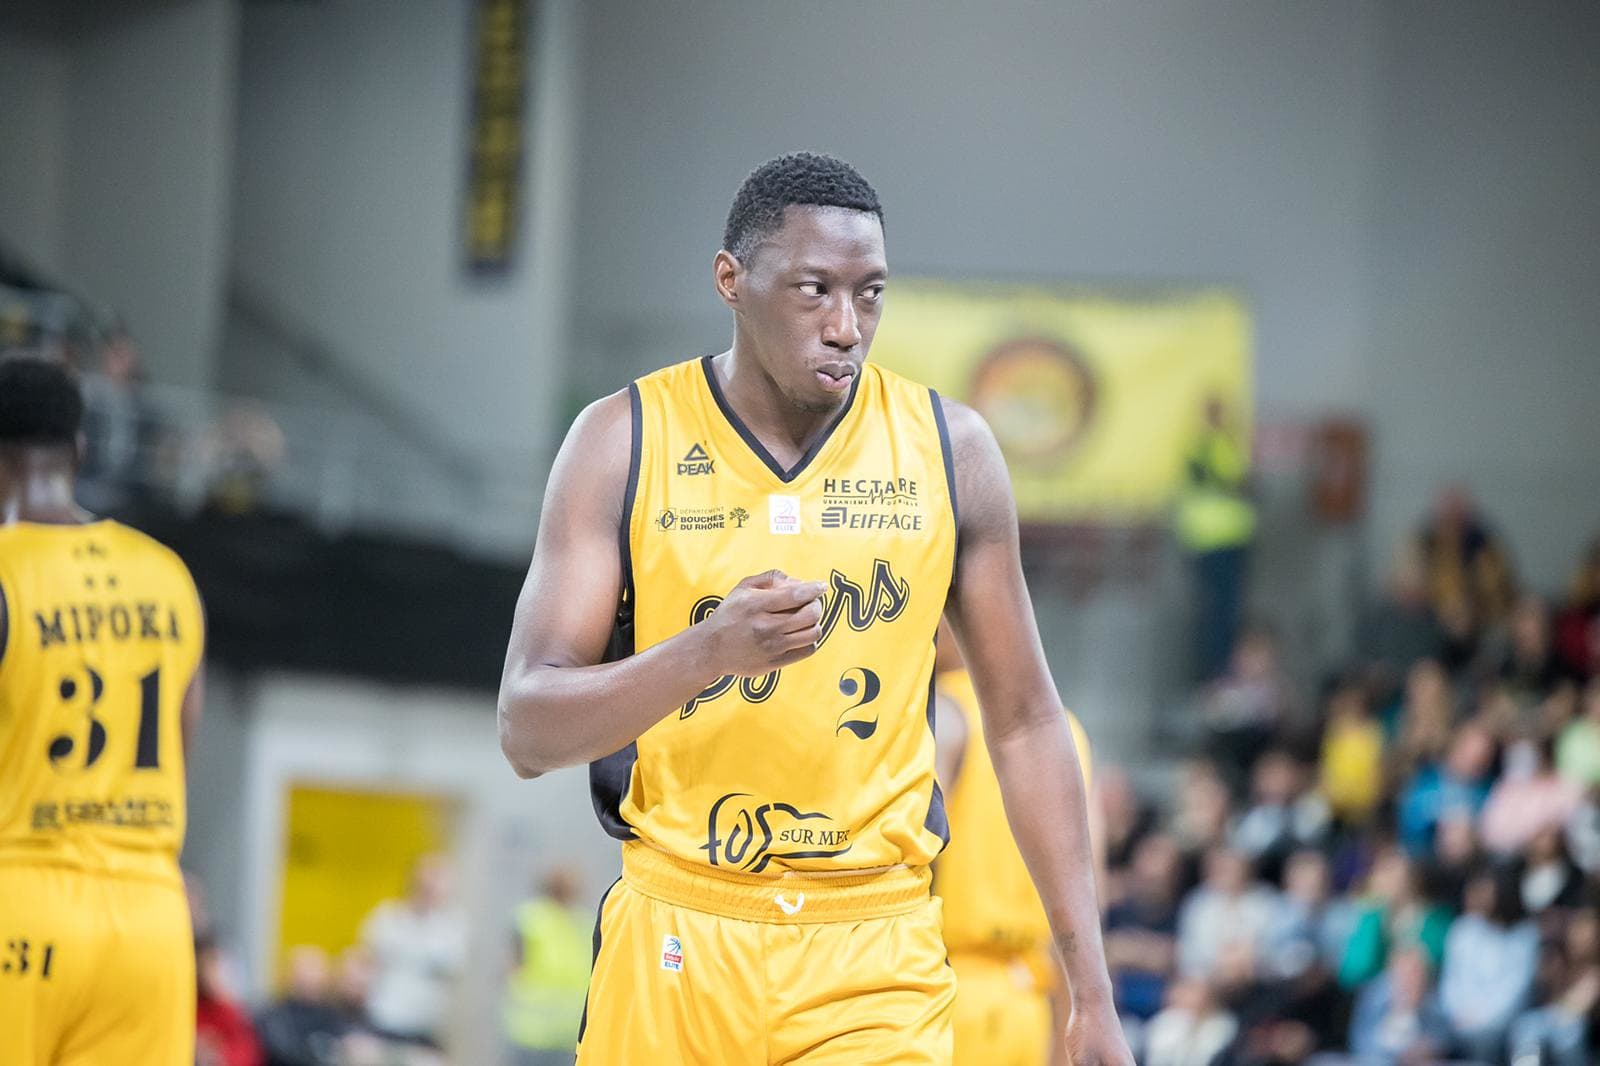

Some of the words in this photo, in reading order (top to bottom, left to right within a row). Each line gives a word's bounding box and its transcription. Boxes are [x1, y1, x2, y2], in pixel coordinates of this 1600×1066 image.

[677, 461, 715, 475] PEAK
[824, 477, 917, 495] HECTARE
[680, 514, 725, 523] BOUCHES
[680, 523, 693, 531] DU
[694, 521, 725, 531] RHÔNE
[849, 513, 922, 530] EIFFAGE
[36, 602, 182, 648] MIPOKA
[836, 667, 881, 740] 2
[48, 661, 161, 770] 31
[779, 828, 814, 844] SUR
[2, 938, 53, 978] 31
